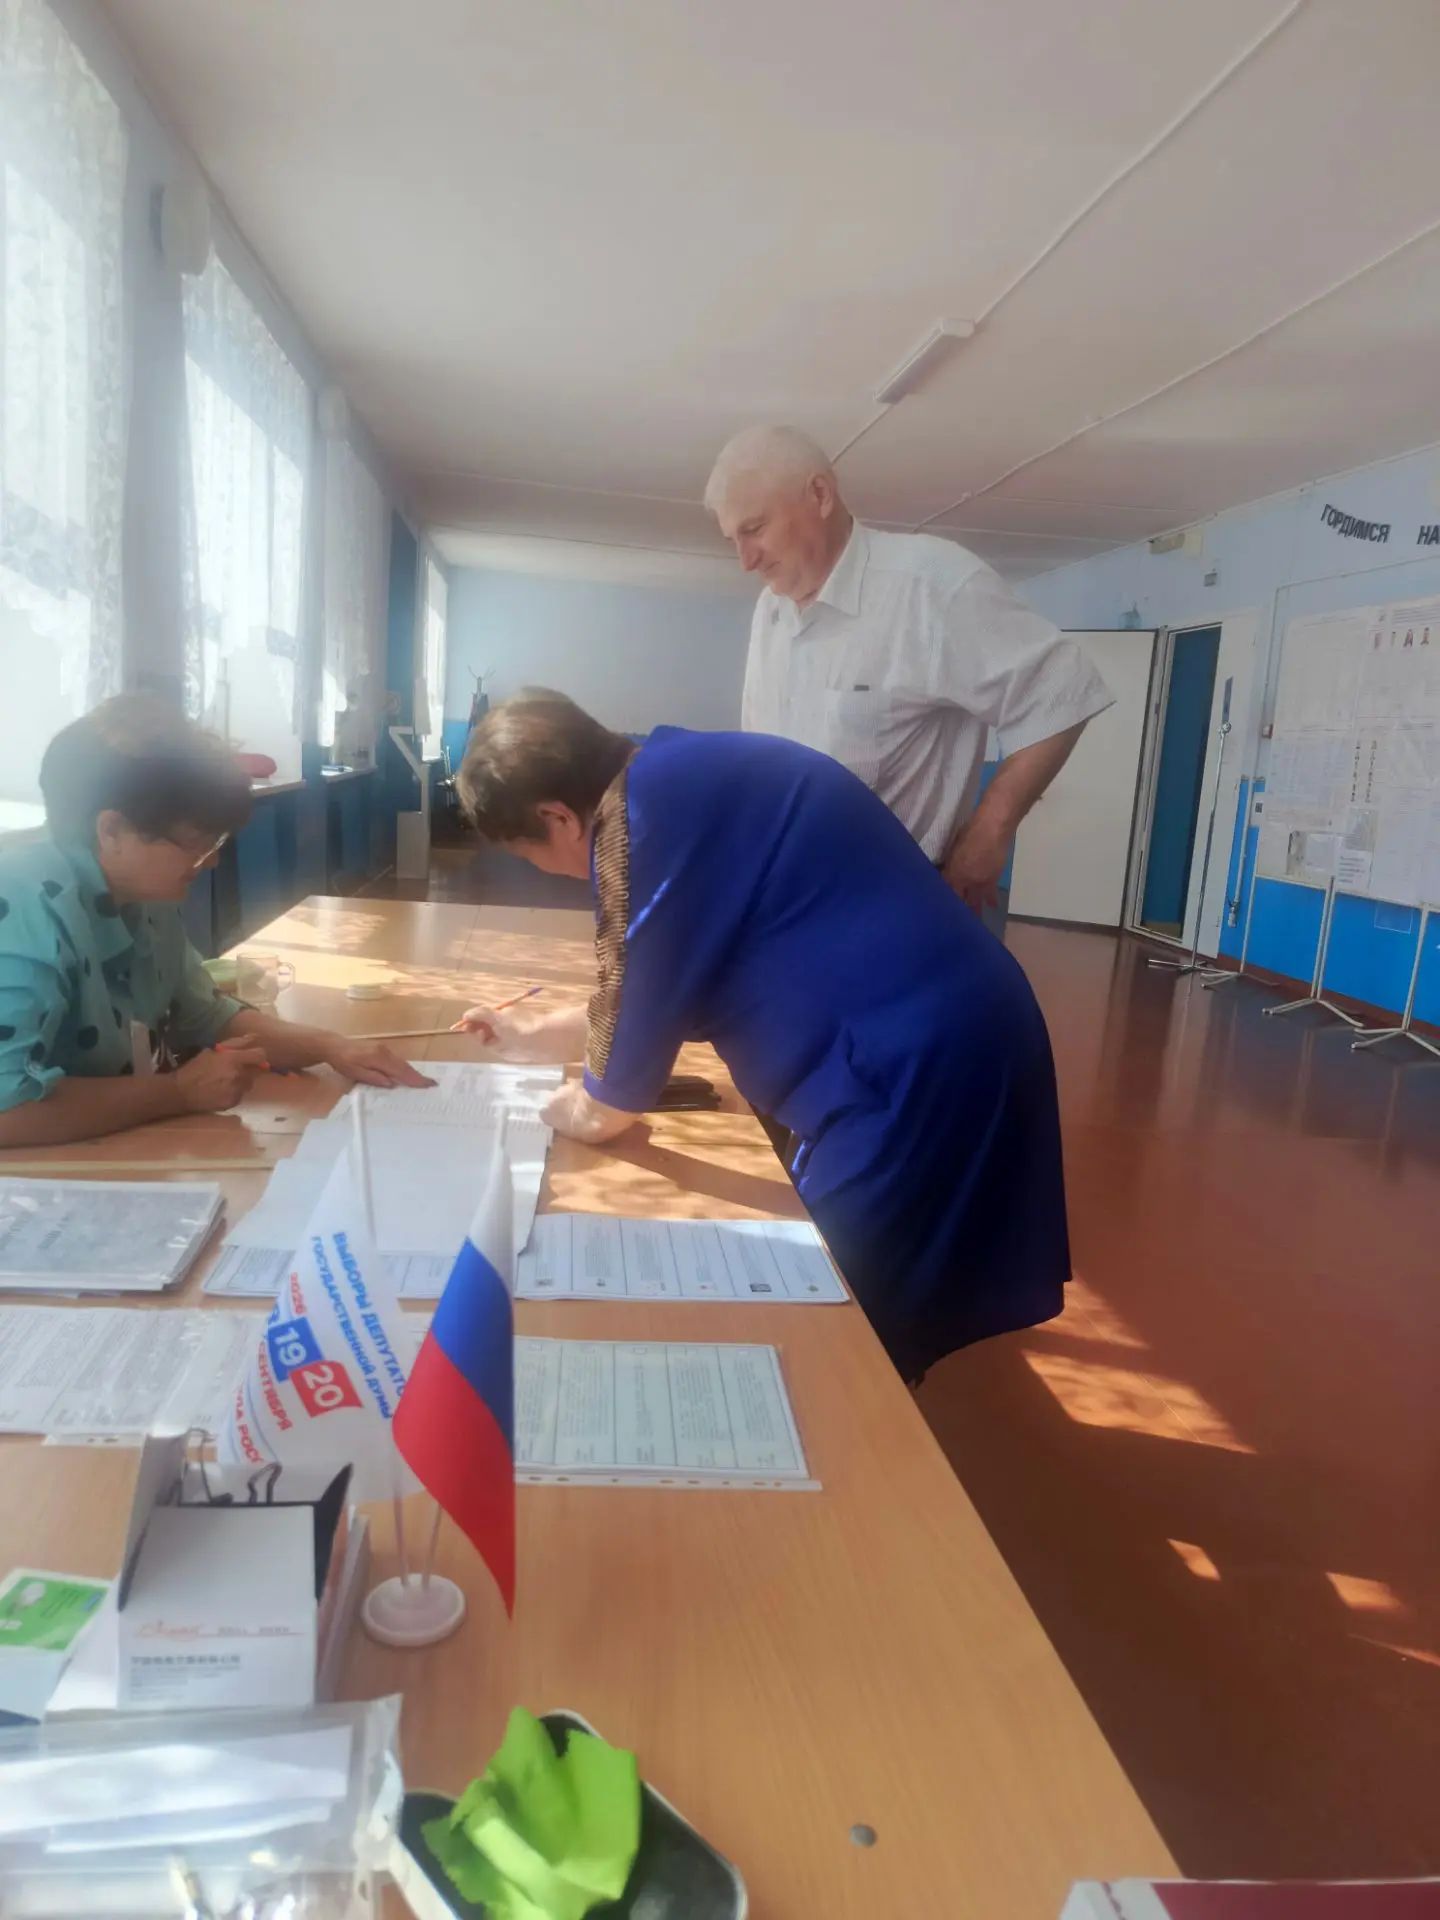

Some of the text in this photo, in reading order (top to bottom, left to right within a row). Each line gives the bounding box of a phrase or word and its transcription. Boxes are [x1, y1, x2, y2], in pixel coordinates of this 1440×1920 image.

[1320, 503, 1391, 544] ГОРДИМСЯ
[333, 1232, 371, 1310] ВЫБОРЫ
[274, 1326, 344, 1408] 19 20
[312, 1236, 394, 1419] ГОСУДАРСТВЕННОЙ ДУМЫ
[258, 1339, 293, 1431] СЕНТЯБРЯ
